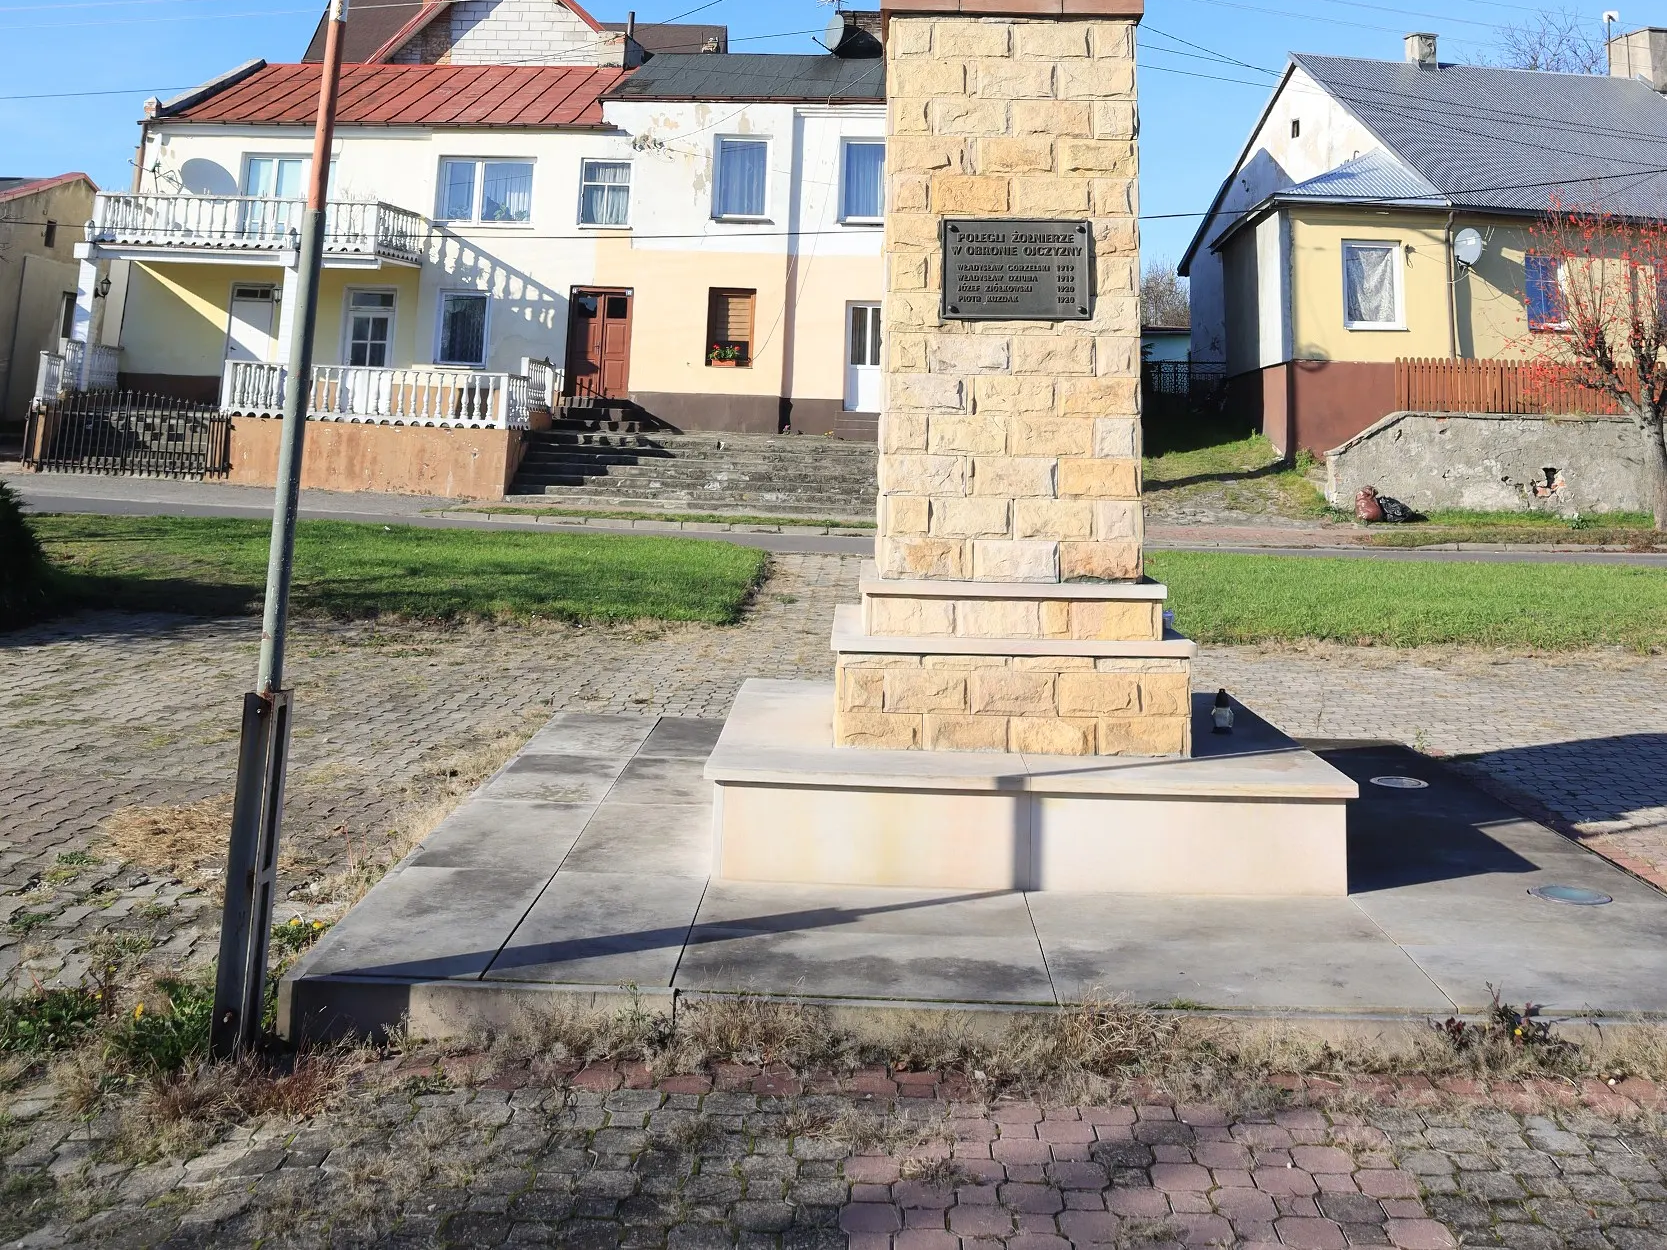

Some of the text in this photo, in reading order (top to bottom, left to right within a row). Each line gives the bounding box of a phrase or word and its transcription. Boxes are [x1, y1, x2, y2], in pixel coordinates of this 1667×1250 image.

[957, 231, 1075, 244] POLEGLI ŻOŁNIERZE
[951, 246, 1083, 257] W OBRONIE OJCZYZNY
[956, 264, 1004, 272] WŁADYSŁAW
[1057, 264, 1075, 272] 1919
[1008, 275, 1039, 283] DZIUBA
[1057, 275, 1075, 283] 1919
[957, 283, 981, 292] JÓZEF
[984, 283, 1033, 293] ZIÓŁKOWSKI
[1057, 296, 1075, 304] 1920
